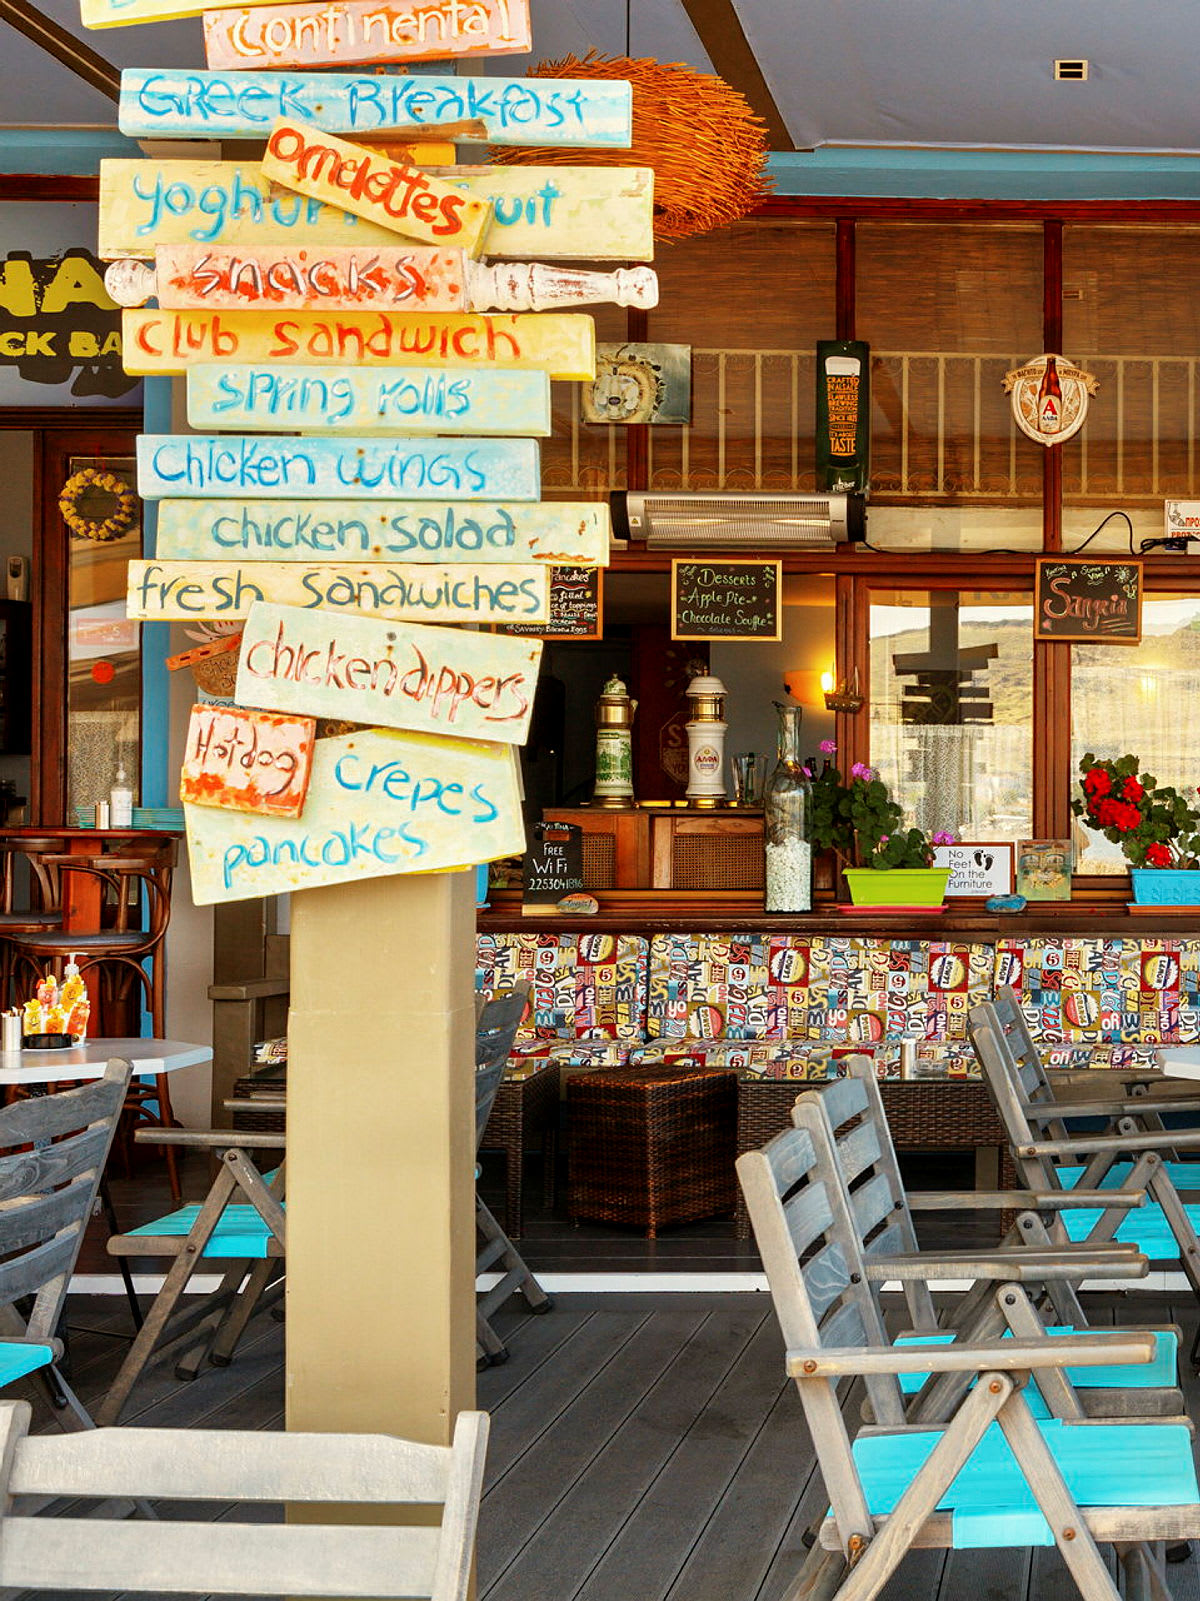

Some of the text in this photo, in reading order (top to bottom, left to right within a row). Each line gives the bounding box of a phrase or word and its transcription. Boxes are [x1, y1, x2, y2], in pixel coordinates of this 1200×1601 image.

[231, 0, 513, 57] Continental
[268, 126, 467, 236] omelettes
[132, 168, 359, 242] yoghur
[268, 313, 522, 359] sandwich
[378, 373, 472, 419] rolls
[830, 438, 856, 453] TASTE
[687, 586, 723, 609] Apple
[245, 619, 530, 723] chicken dippers
[222, 820, 431, 889] pancakes
[543, 842, 564, 856] FREE
[948, 850, 964, 859] No
[948, 859, 972, 869] Feet
[948, 879, 993, 889] Furniture
[968, 869, 985, 879] the
